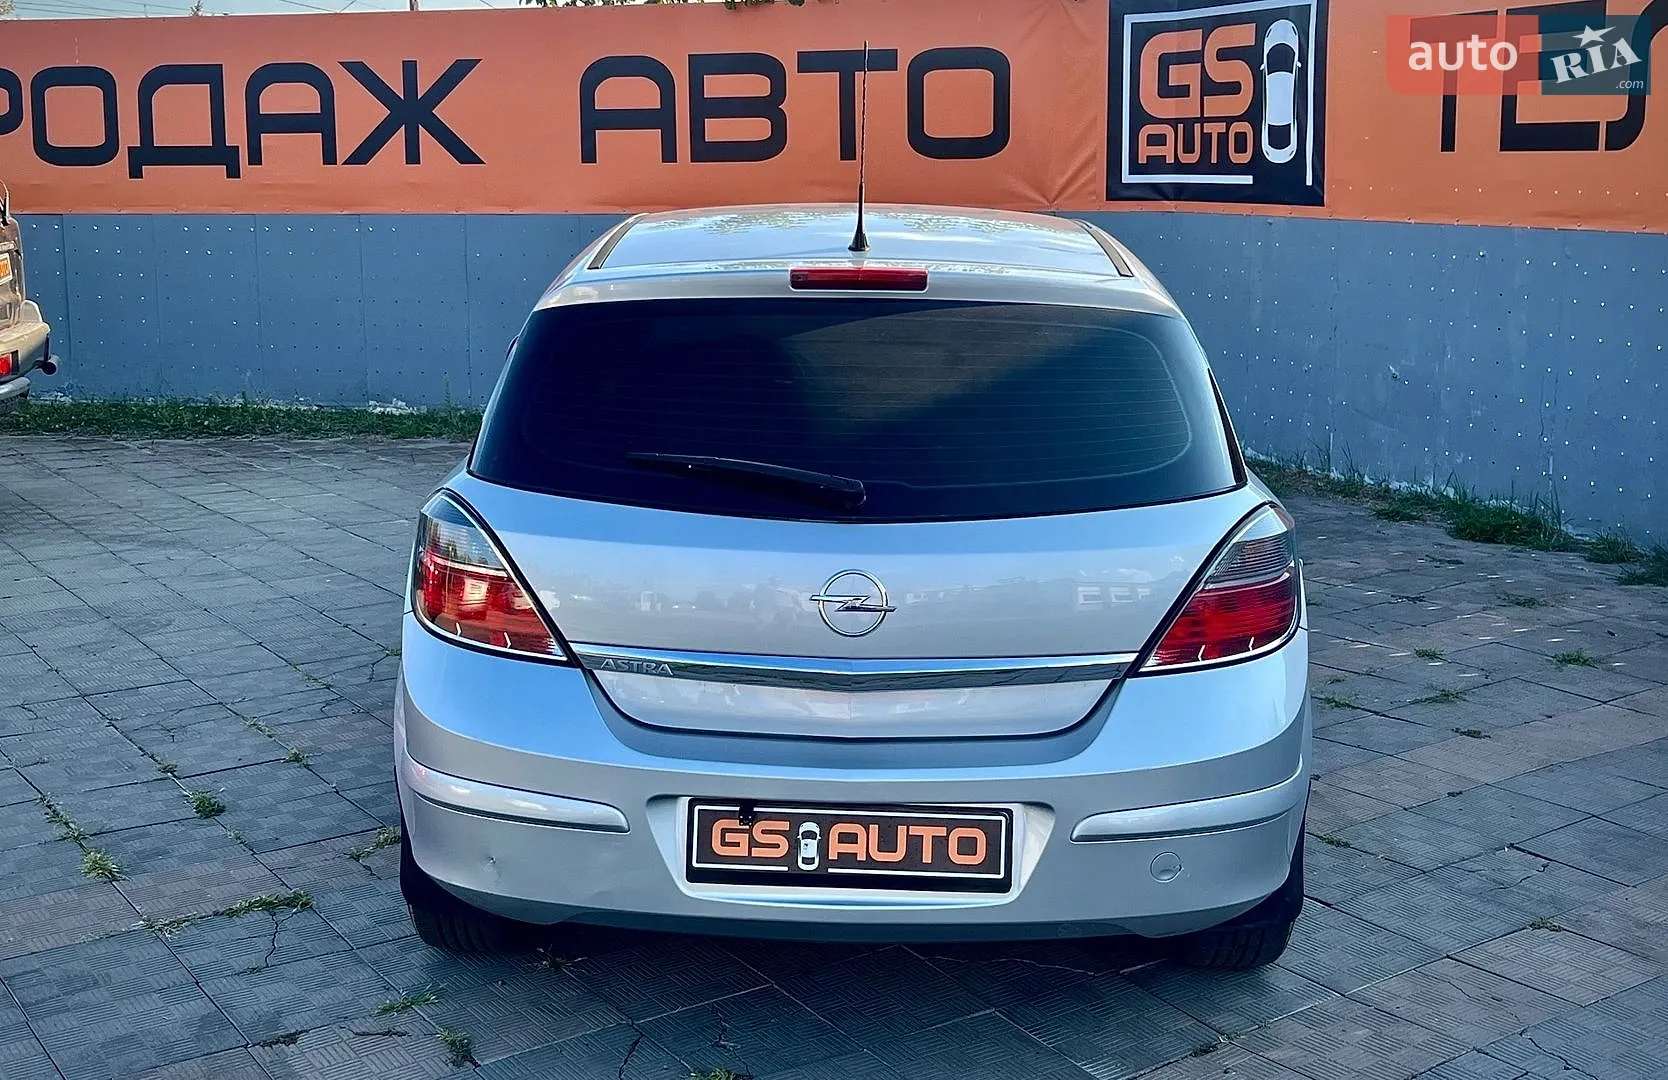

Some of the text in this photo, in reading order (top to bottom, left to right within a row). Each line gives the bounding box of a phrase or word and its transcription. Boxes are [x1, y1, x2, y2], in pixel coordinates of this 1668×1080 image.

[1139, 22, 1256, 119] GS
[0, 46, 1011, 179] ОДАЖ АВТО
[1138, 121, 1254, 165] AUTO
[600, 658, 674, 676] ASTRA
[711, 818, 987, 866] GS AUTO
